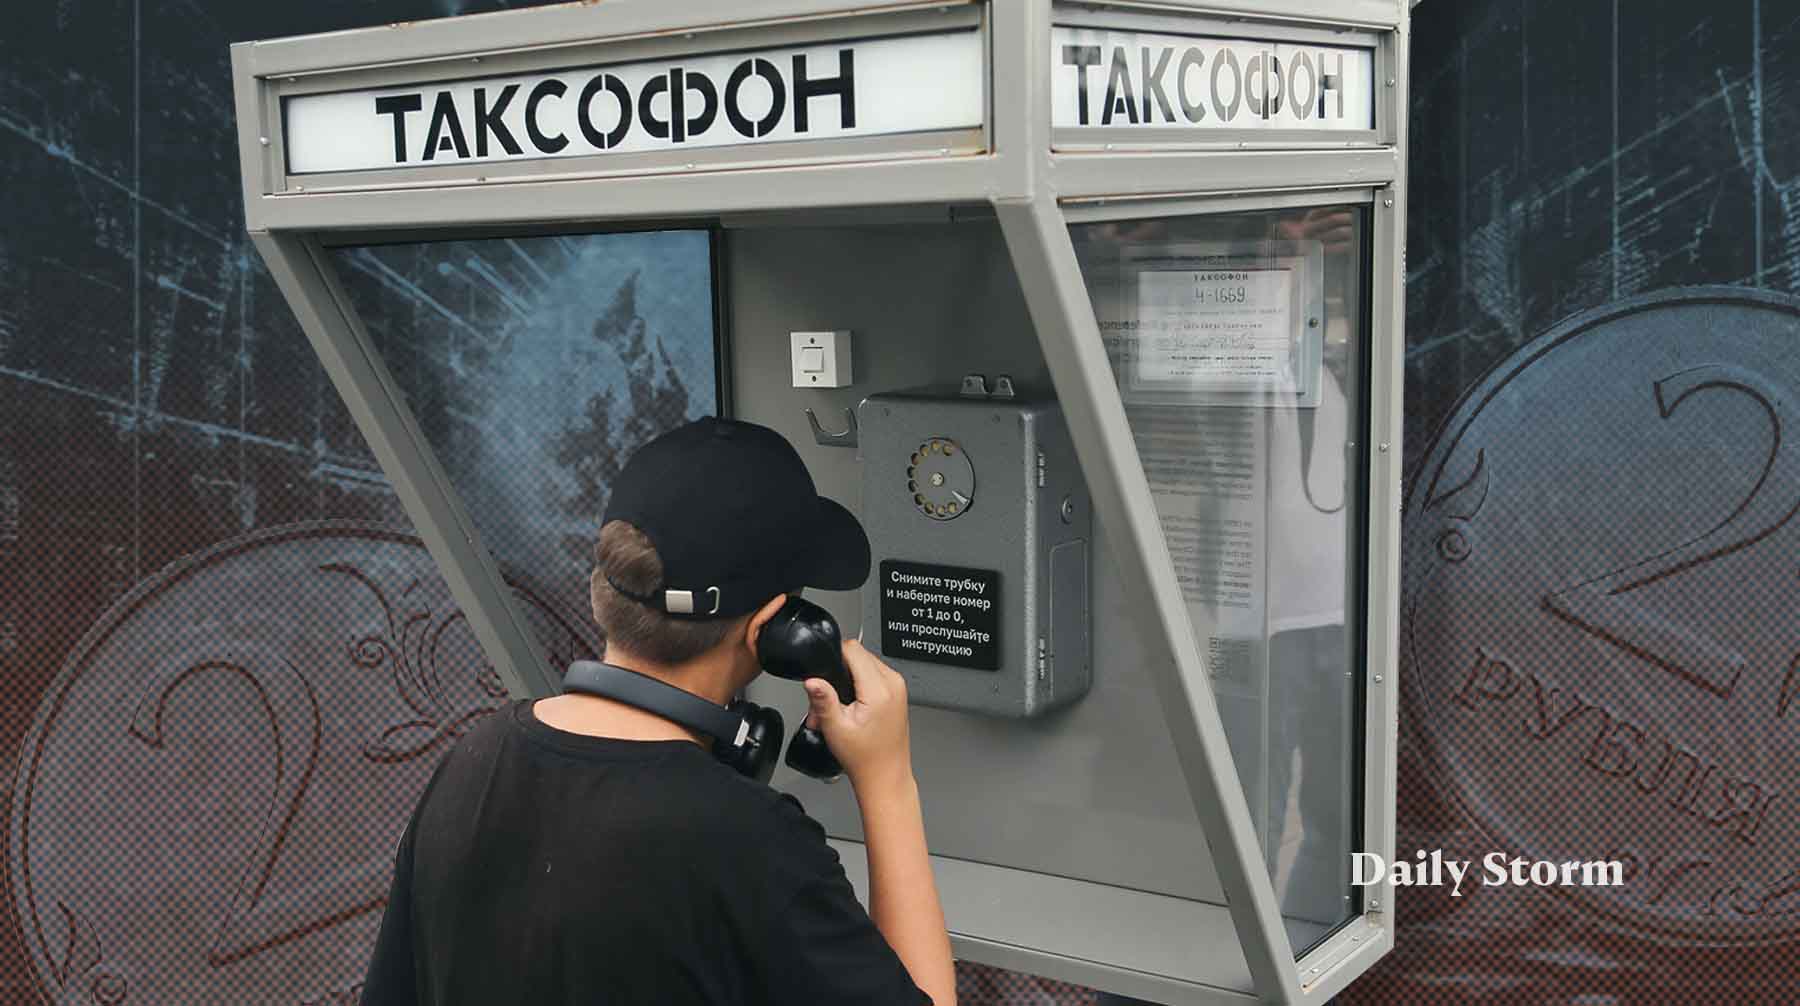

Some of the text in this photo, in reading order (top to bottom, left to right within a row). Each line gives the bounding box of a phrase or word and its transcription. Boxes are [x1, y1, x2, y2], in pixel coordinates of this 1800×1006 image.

[1062, 45, 1344, 125] ТАКСОФОН
[375, 49, 855, 163] ТАКСОФОН
[891, 571, 985, 593] Снимите трубку
[887, 588, 991, 611] и наберите номер
[911, 608, 964, 624] от 1 до 0,
[888, 621, 990, 642] или прослушайте
[902, 639, 972, 656] инструкцию
[1451, 647, 1777, 845] РУБЛЯ
